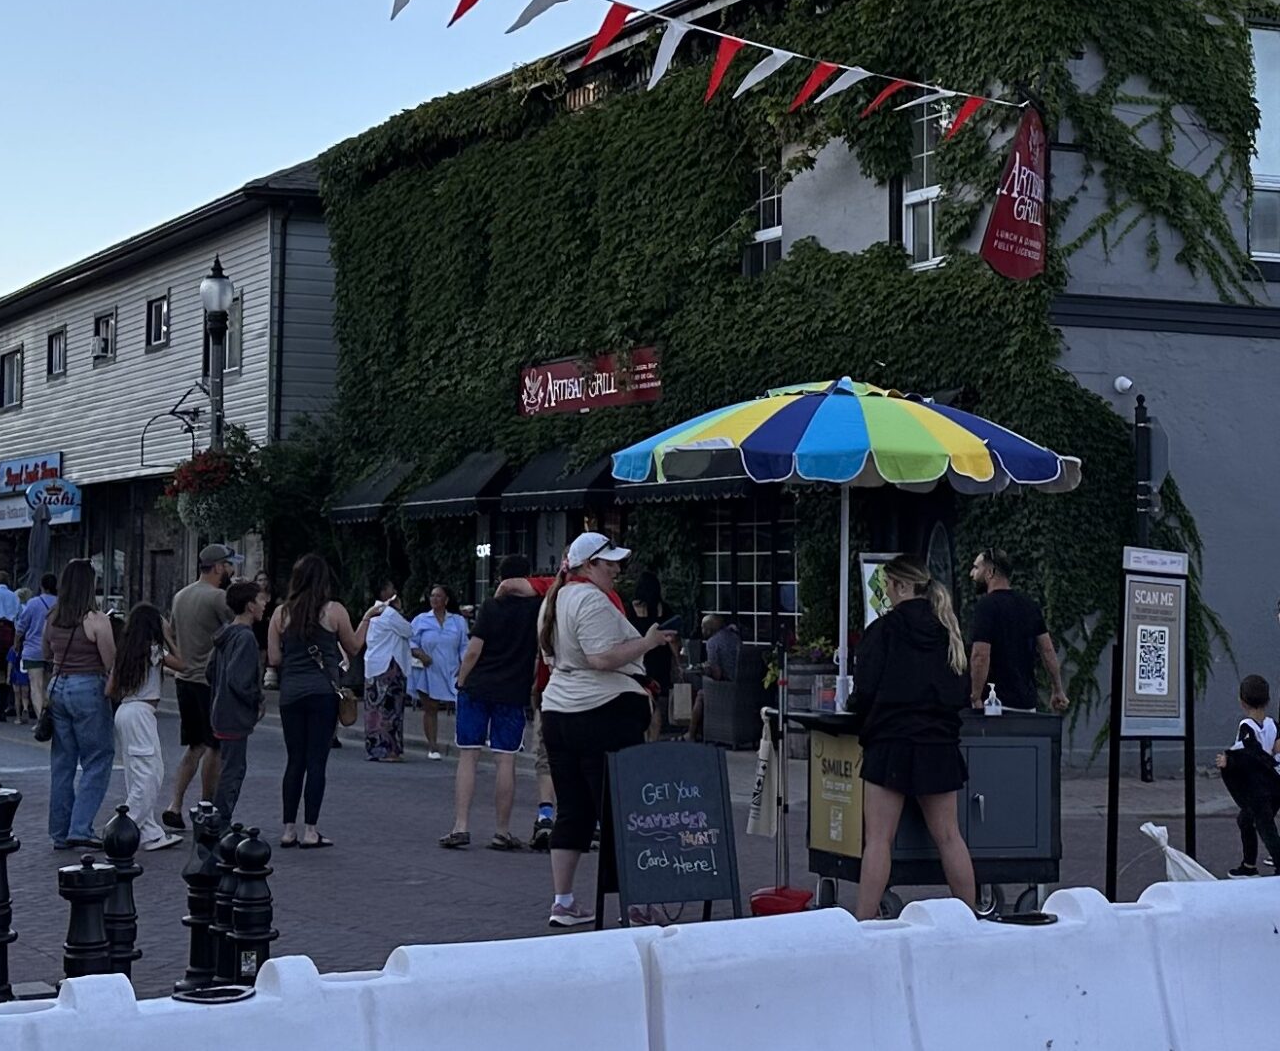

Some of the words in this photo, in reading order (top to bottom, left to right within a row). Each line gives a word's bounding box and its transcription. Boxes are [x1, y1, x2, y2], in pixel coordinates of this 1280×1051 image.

[1013, 195, 1043, 226] GRILL
[995, 228, 1018, 242] LUNCH
[993, 238, 1014, 252] FULLY
[32, 490, 76, 506] Sushi
[1134, 589, 1159, 605] SCAN
[1160, 592, 1174, 606] ME
[822, 758, 852, 778] SMILE!
[641, 782, 670, 806] GET
[673, 781, 702, 804] YOUR
[626, 810, 709, 831] SCAVENGER
[678, 828, 720, 847] HUNT
[637, 848, 670, 870] Card
[672, 847, 718, 876] Here!
